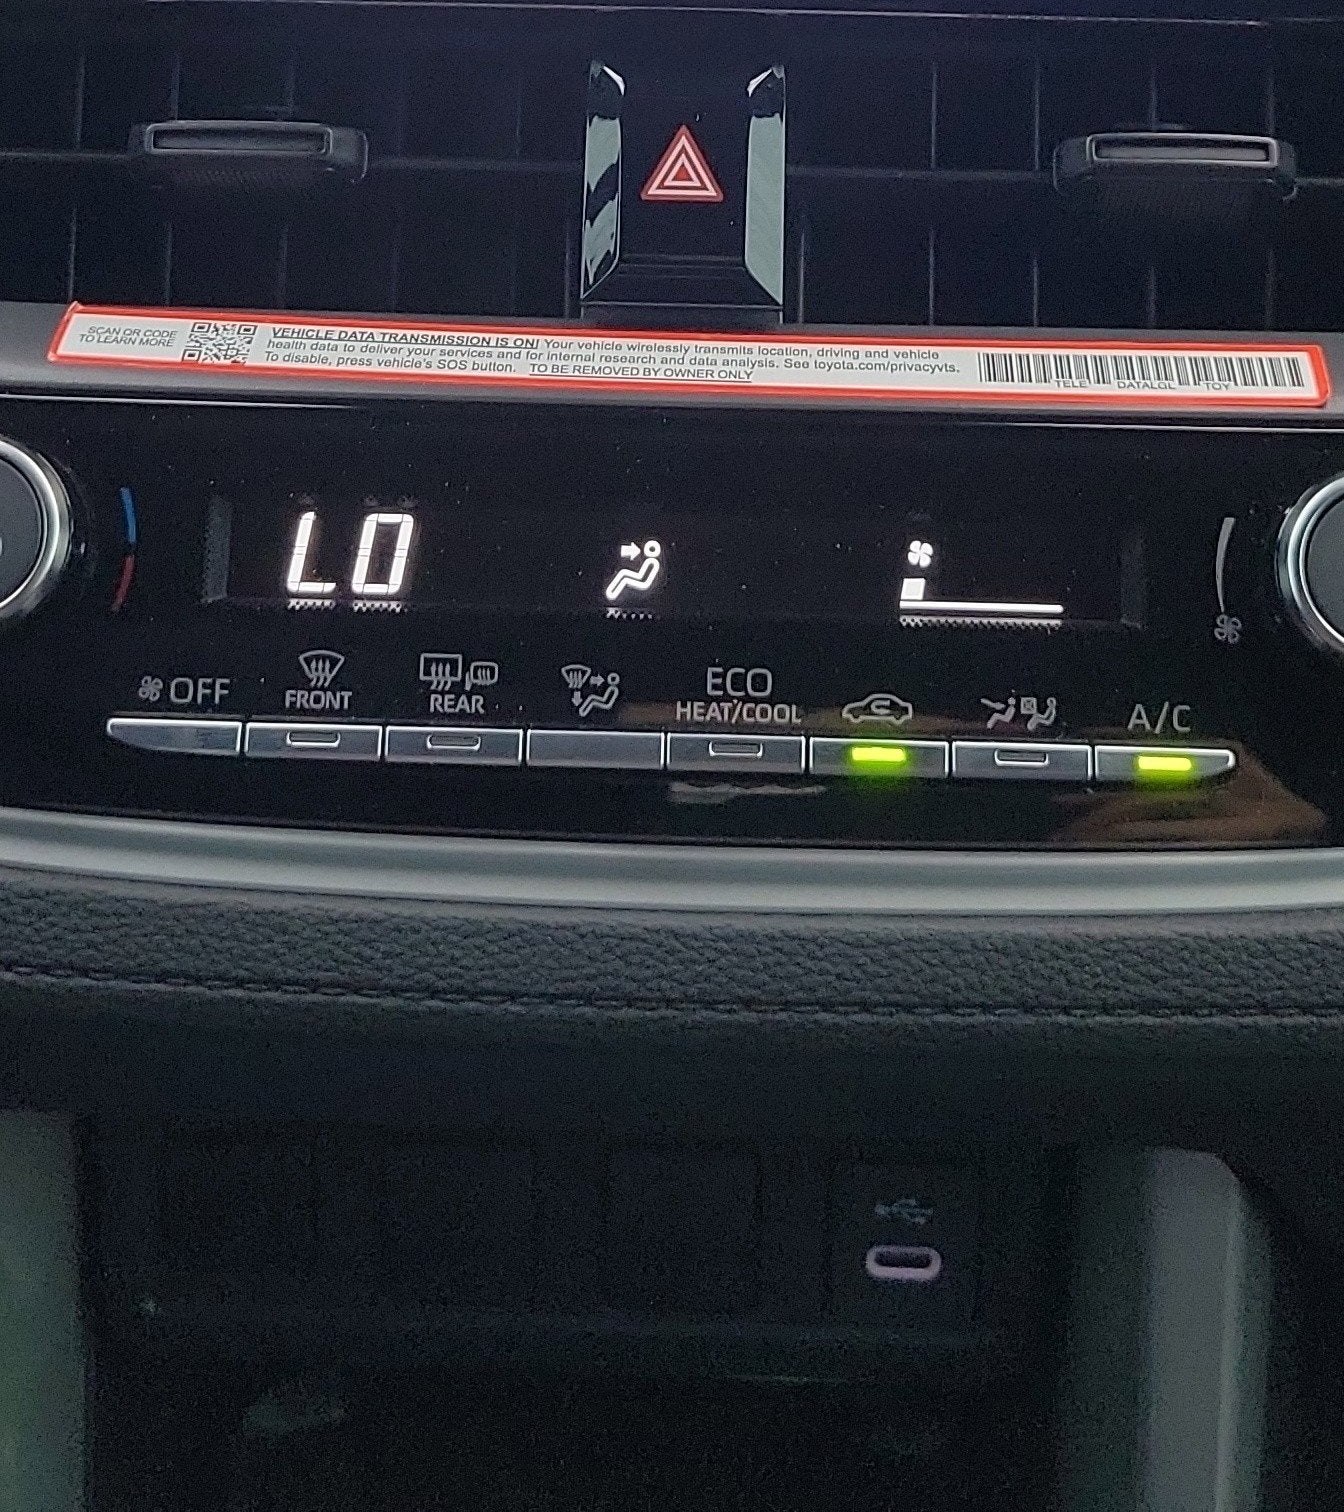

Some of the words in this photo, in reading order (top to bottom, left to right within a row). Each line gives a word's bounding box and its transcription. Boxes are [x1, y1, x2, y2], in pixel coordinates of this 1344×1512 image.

[79, 334, 95, 343] TO
[97, 335, 137, 345] LEARN
[138, 338, 176, 347] MORE
[88, 326, 121, 335] SCAN
[144, 329, 178, 338] CODE
[272, 327, 335, 339] VEHICLE
[338, 330, 375, 342] DATA
[380, 332, 491, 347] TRANSMISSION
[495, 336, 510, 348] IS
[544, 338, 574, 350] Your
[577, 340, 623, 351] vehicle
[626, 342, 691, 355] wirelessly
[694, 344, 754, 355] transmits
[758, 346, 813, 358] location,
[816, 348, 860, 360] driving
[864, 349, 889, 359] and
[893, 350, 939, 360] vehicle
[264, 351, 279, 362] To
[282, 352, 332, 366] disable,
[336, 355, 373, 367] press
[376, 356, 433, 369] vehicle's
[436, 358, 468, 371] SOS
[471, 360, 517, 373] button.
[530, 363, 548, 374] TO
[551, 364, 570, 374] BE
[572, 364, 640, 376] REMOVED
[642, 367, 661, 377] BY
[663, 367, 715, 379] OWNER
[717, 369, 754, 380] ONLY
[266, 339, 307, 350] health
[309, 341, 339, 352] data
[343, 342, 356, 353] to
[360, 343, 404, 355] deliver
[406, 346, 436, 358] your
[439, 348, 493, 359] services
[497, 349, 522, 360] and
[525, 350, 543, 361] for
[546, 351, 596, 363] internal
[599, 353, 656, 365] research
[660, 354, 685, 365] and
[689, 355, 718, 366] data
[721, 357, 779, 369] analysis.
[783, 358, 810, 369] See
[1055, 379, 1088, 389] TELE
[169, 676, 231, 705] OFF
[706, 665, 773, 698] ECO
[285, 689, 353, 711] FRONT
[429, 694, 485, 714] REAR
[675, 697, 802, 724] HEAT/COOL
[1127, 702, 1192, 735] A/C
